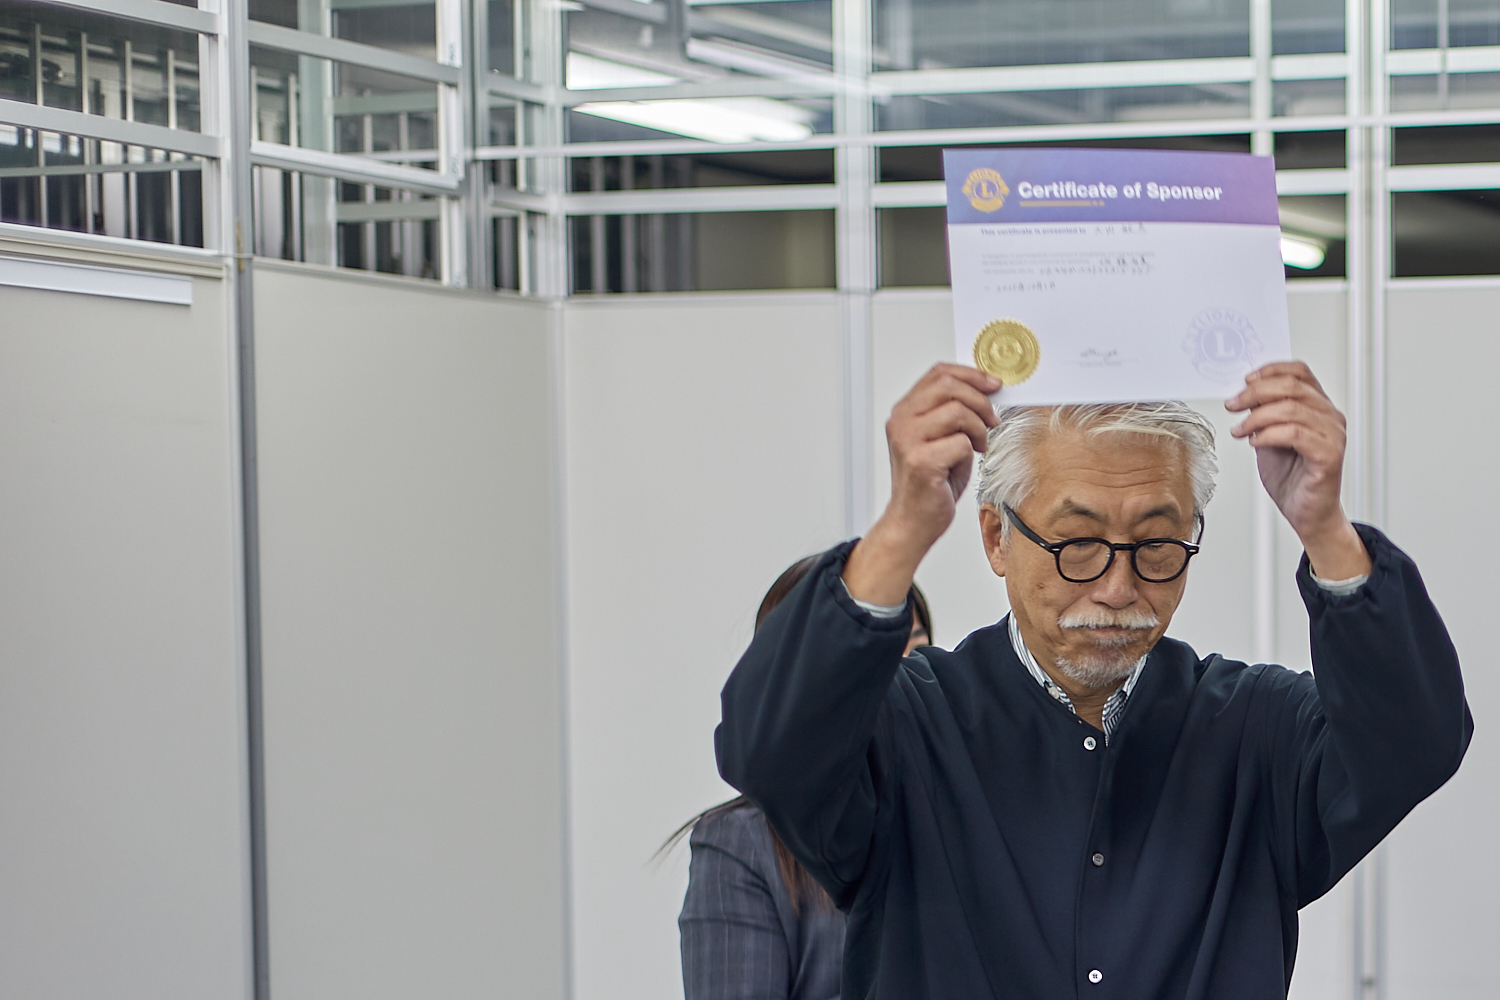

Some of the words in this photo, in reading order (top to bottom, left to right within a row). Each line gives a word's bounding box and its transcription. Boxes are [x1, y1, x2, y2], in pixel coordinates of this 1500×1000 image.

[981, 182, 994, 197] L
[1018, 181, 1118, 200] Certificate
[1123, 181, 1143, 199] of
[1146, 182, 1223, 202] Sponsor
[1034, 227, 1041, 235] is
[1042, 228, 1078, 236] presented
[1079, 227, 1087, 235] to
[1213, 330, 1237, 359] L
